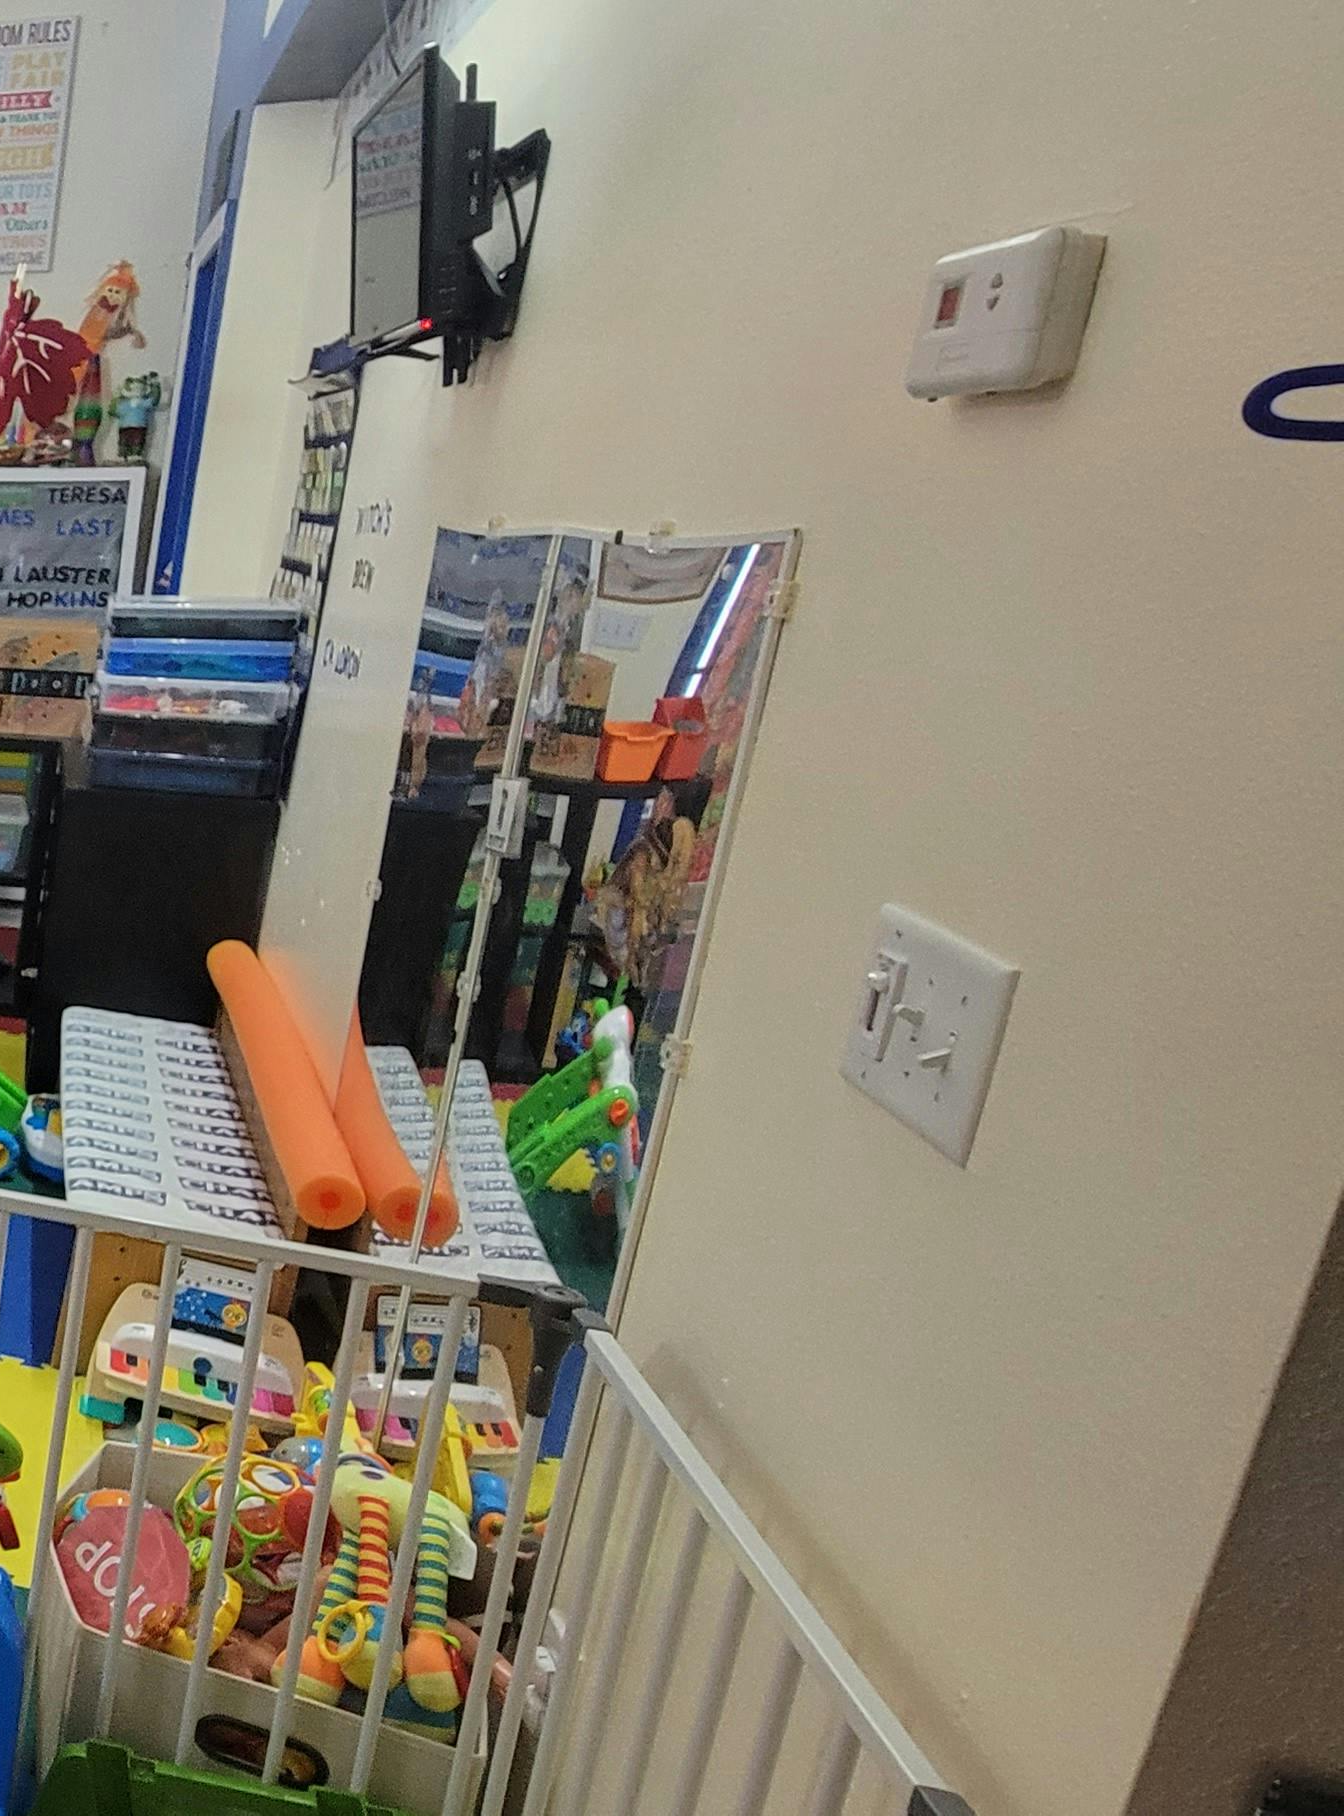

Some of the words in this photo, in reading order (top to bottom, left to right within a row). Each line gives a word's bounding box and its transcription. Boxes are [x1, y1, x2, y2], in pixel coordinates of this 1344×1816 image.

[27, 19, 72, 45] RULES
[12, 52, 67, 70] PLAY
[48, 486, 128, 505] TERESA
[56, 518, 116, 538] LAST
[14, 565, 111, 584] LAUSTER
[6, 591, 110, 609] HOPKINS
